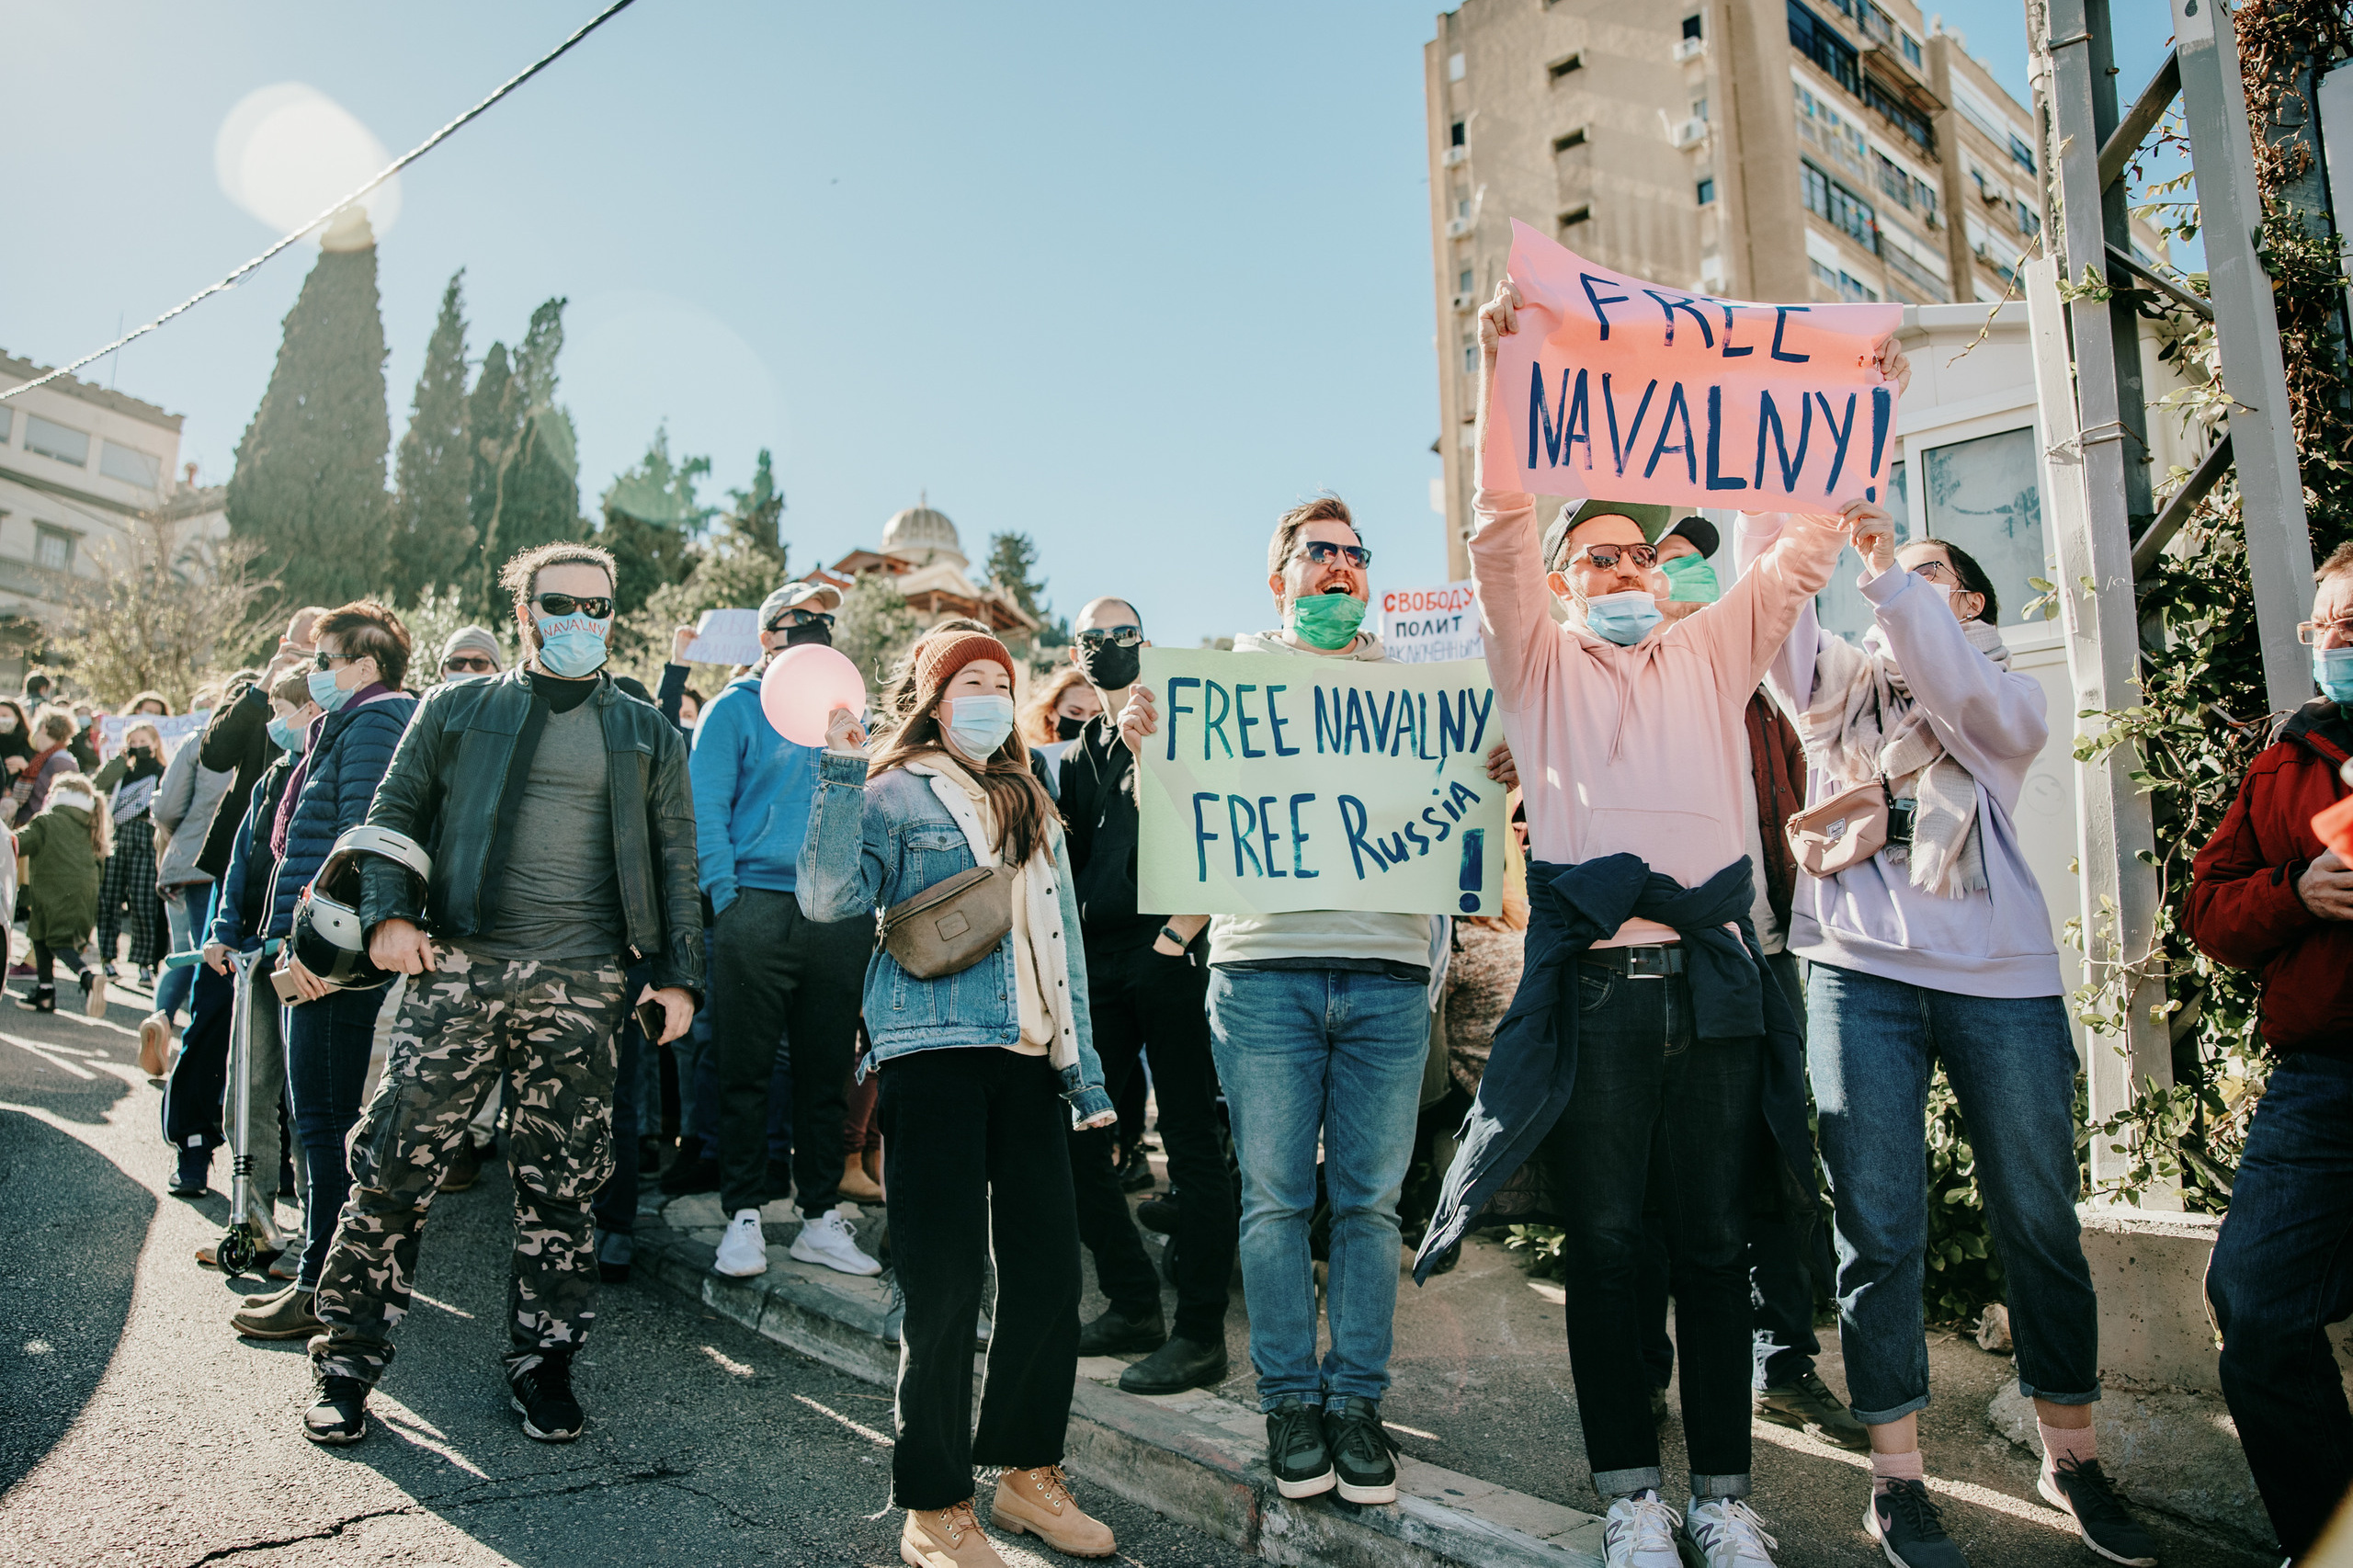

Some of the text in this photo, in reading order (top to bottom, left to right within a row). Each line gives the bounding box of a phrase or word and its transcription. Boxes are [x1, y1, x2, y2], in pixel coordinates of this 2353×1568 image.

[1527, 360, 1892, 504] NAVALNY!
[1383, 586, 1474, 613] СВОБОДУ
[1395, 615, 1463, 638] ПОЛИТ
[543, 618, 606, 638] NAVALNY
[1167, 676, 1494, 761] FREE NAVALNY
[1192, 791, 1320, 882] FREE
